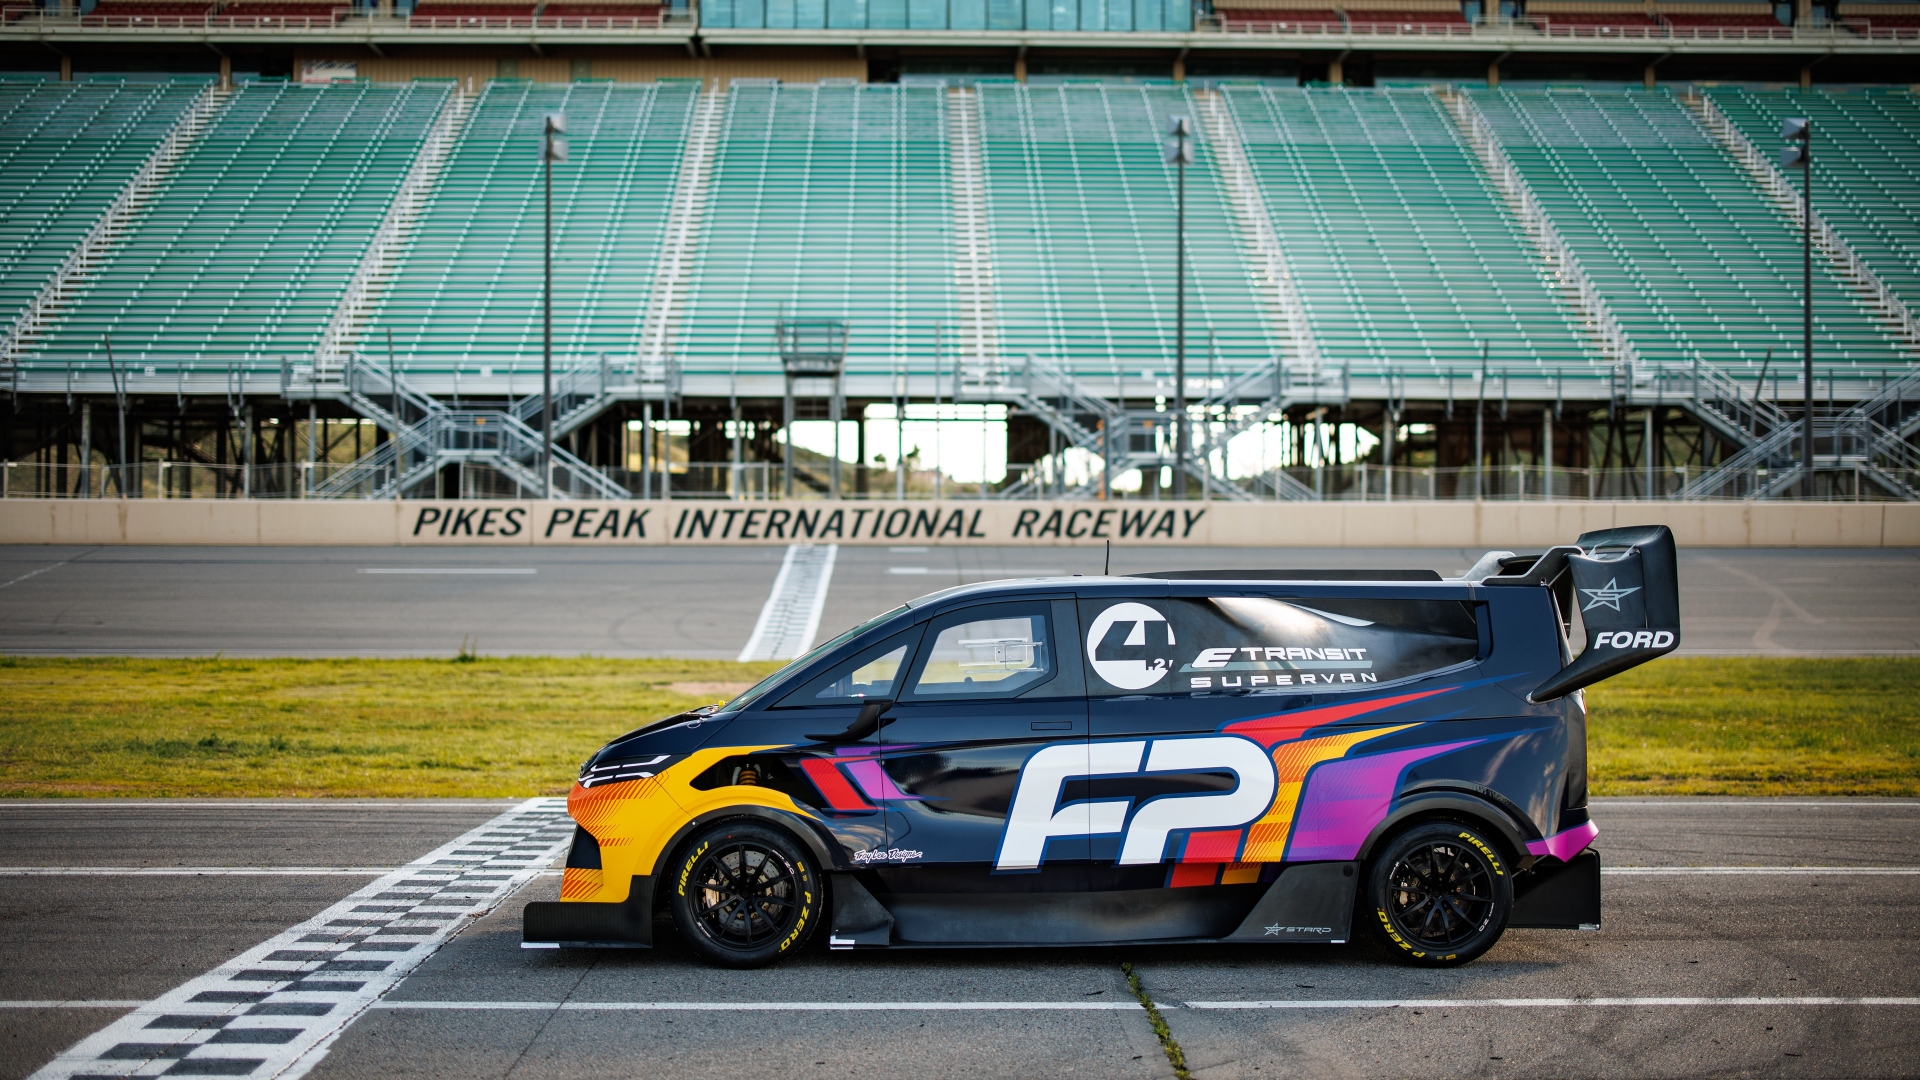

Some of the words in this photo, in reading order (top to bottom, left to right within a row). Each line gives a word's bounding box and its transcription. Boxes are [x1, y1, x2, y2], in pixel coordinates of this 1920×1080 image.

[412, 507, 527, 537] PIKES
[545, 507, 653, 538] PEAK
[673, 508, 986, 539] INTERNATIONAL
[1012, 508, 1206, 539] RACEWAY
[1593, 631, 1675, 650] FORD
[1240, 646, 1367, 661] TRANSIT
[1190, 672, 1378, 689] SUPERVAN
[991, 733, 1278, 874] FP
[854, 849, 872, 864] Troy
[872, 849, 888, 860] Lee
[1458, 832, 1504, 876] PIRELLI
[678, 841, 709, 896] PIRELLI
[804, 891, 811, 904] P
[780, 905, 809, 951] ZERO
[1286, 926, 1332, 935] STARD
[1377, 911, 1413, 951] ZERO
